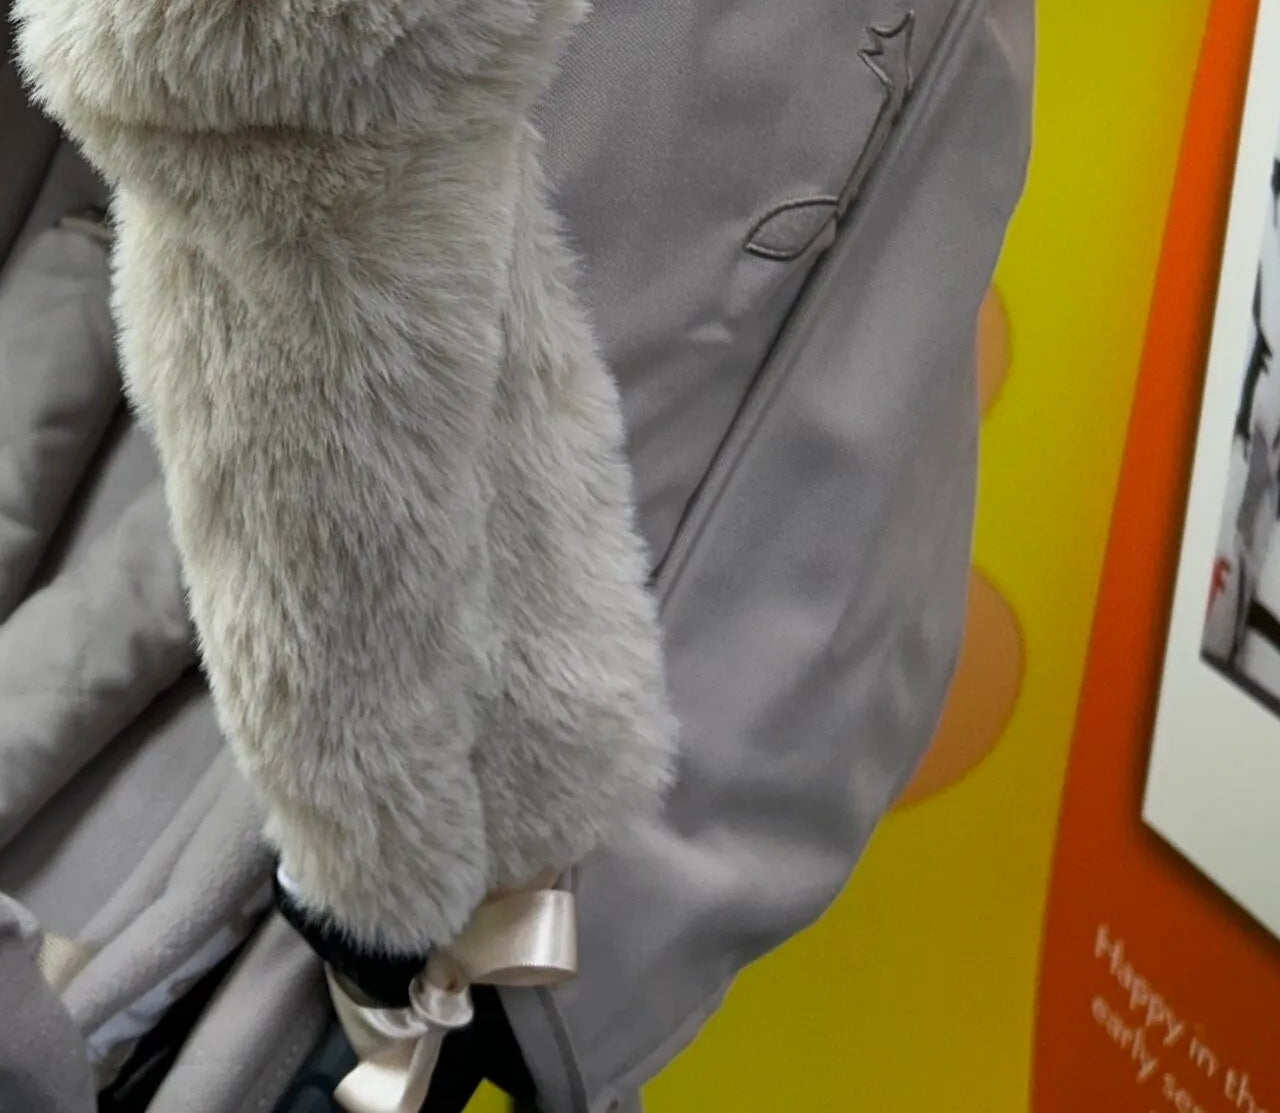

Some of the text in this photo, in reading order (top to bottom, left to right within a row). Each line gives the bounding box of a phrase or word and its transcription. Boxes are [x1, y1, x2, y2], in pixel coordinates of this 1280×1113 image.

[1092, 995, 1158, 1083] early
[1094, 923, 1270, 1113] Happy in th
